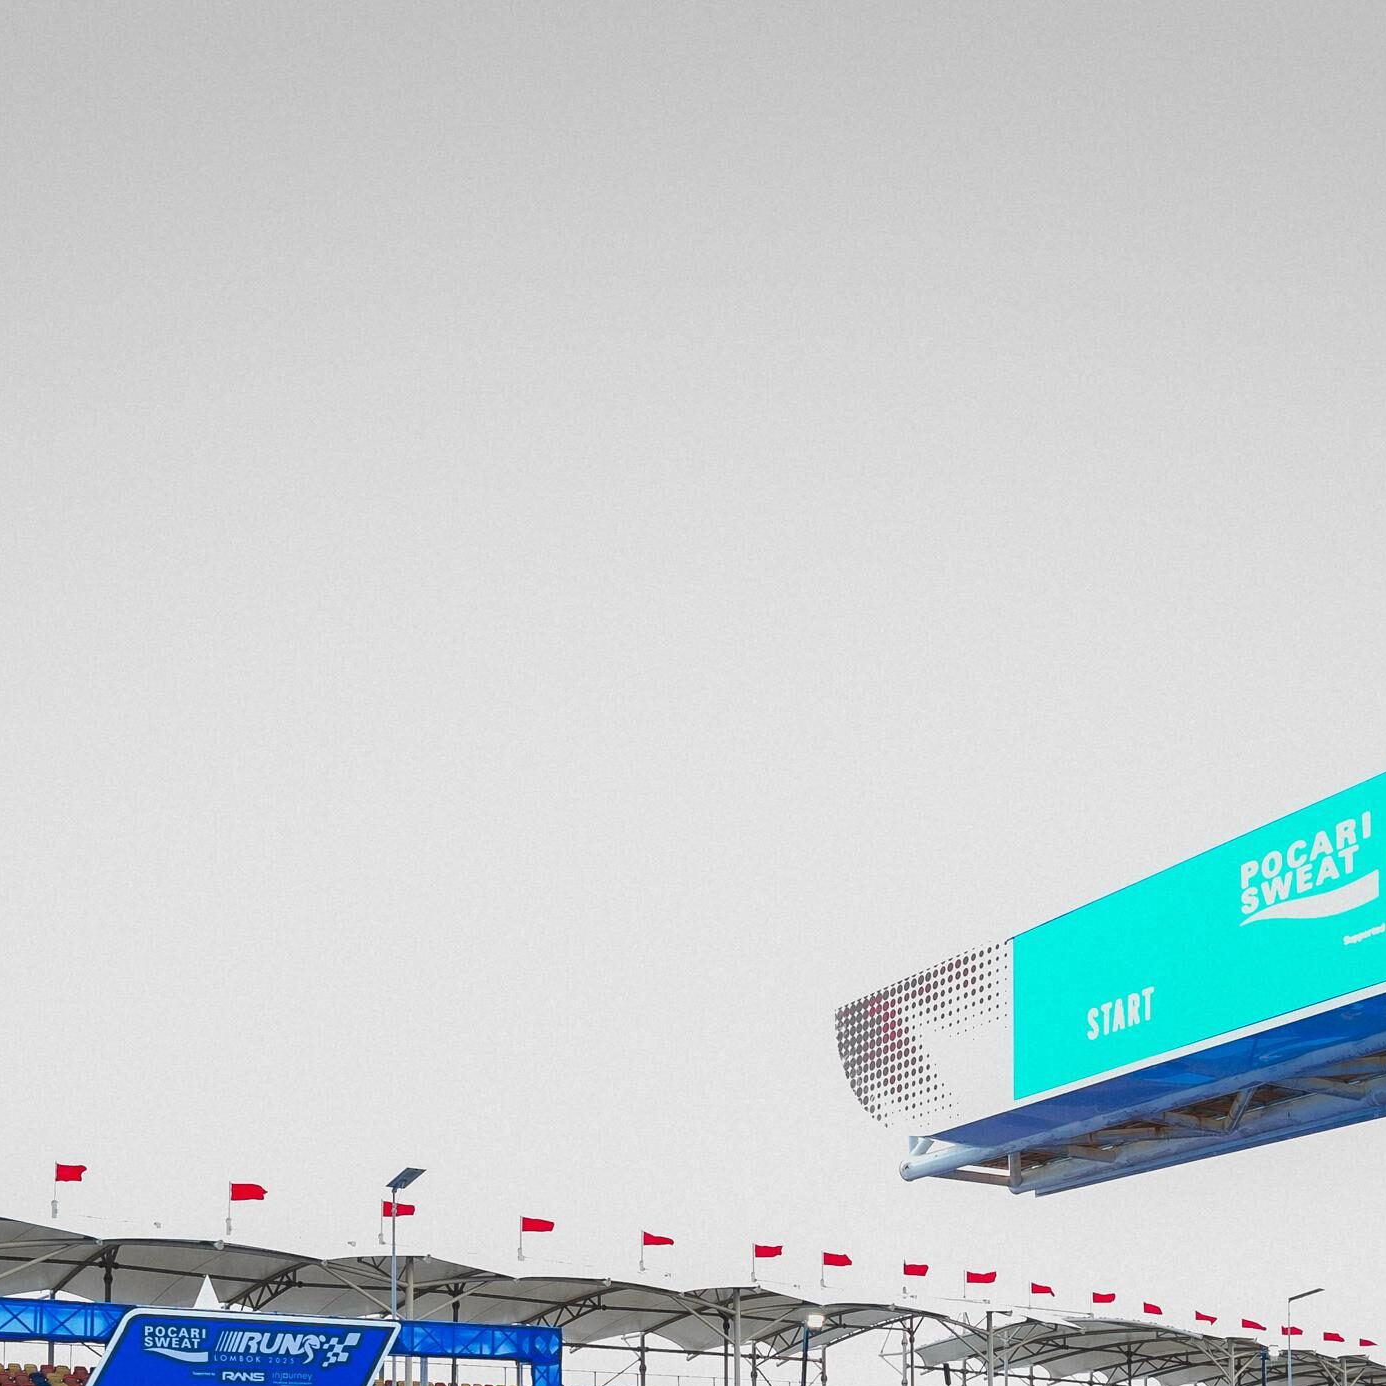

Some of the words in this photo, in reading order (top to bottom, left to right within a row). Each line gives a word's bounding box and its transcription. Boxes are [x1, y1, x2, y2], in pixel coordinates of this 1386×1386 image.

[1241, 811, 1372, 890] POCARI
[1241, 844, 1361, 915] SWEAT
[1086, 986, 1156, 1041] START
[144, 1326, 207, 1339] POCARI
[144, 1336, 201, 1349] SWEAT
[214, 1354, 262, 1363] LOMBOK
[269, 1356, 295, 1364] 2025
[222, 1371, 265, 1382] RANS
